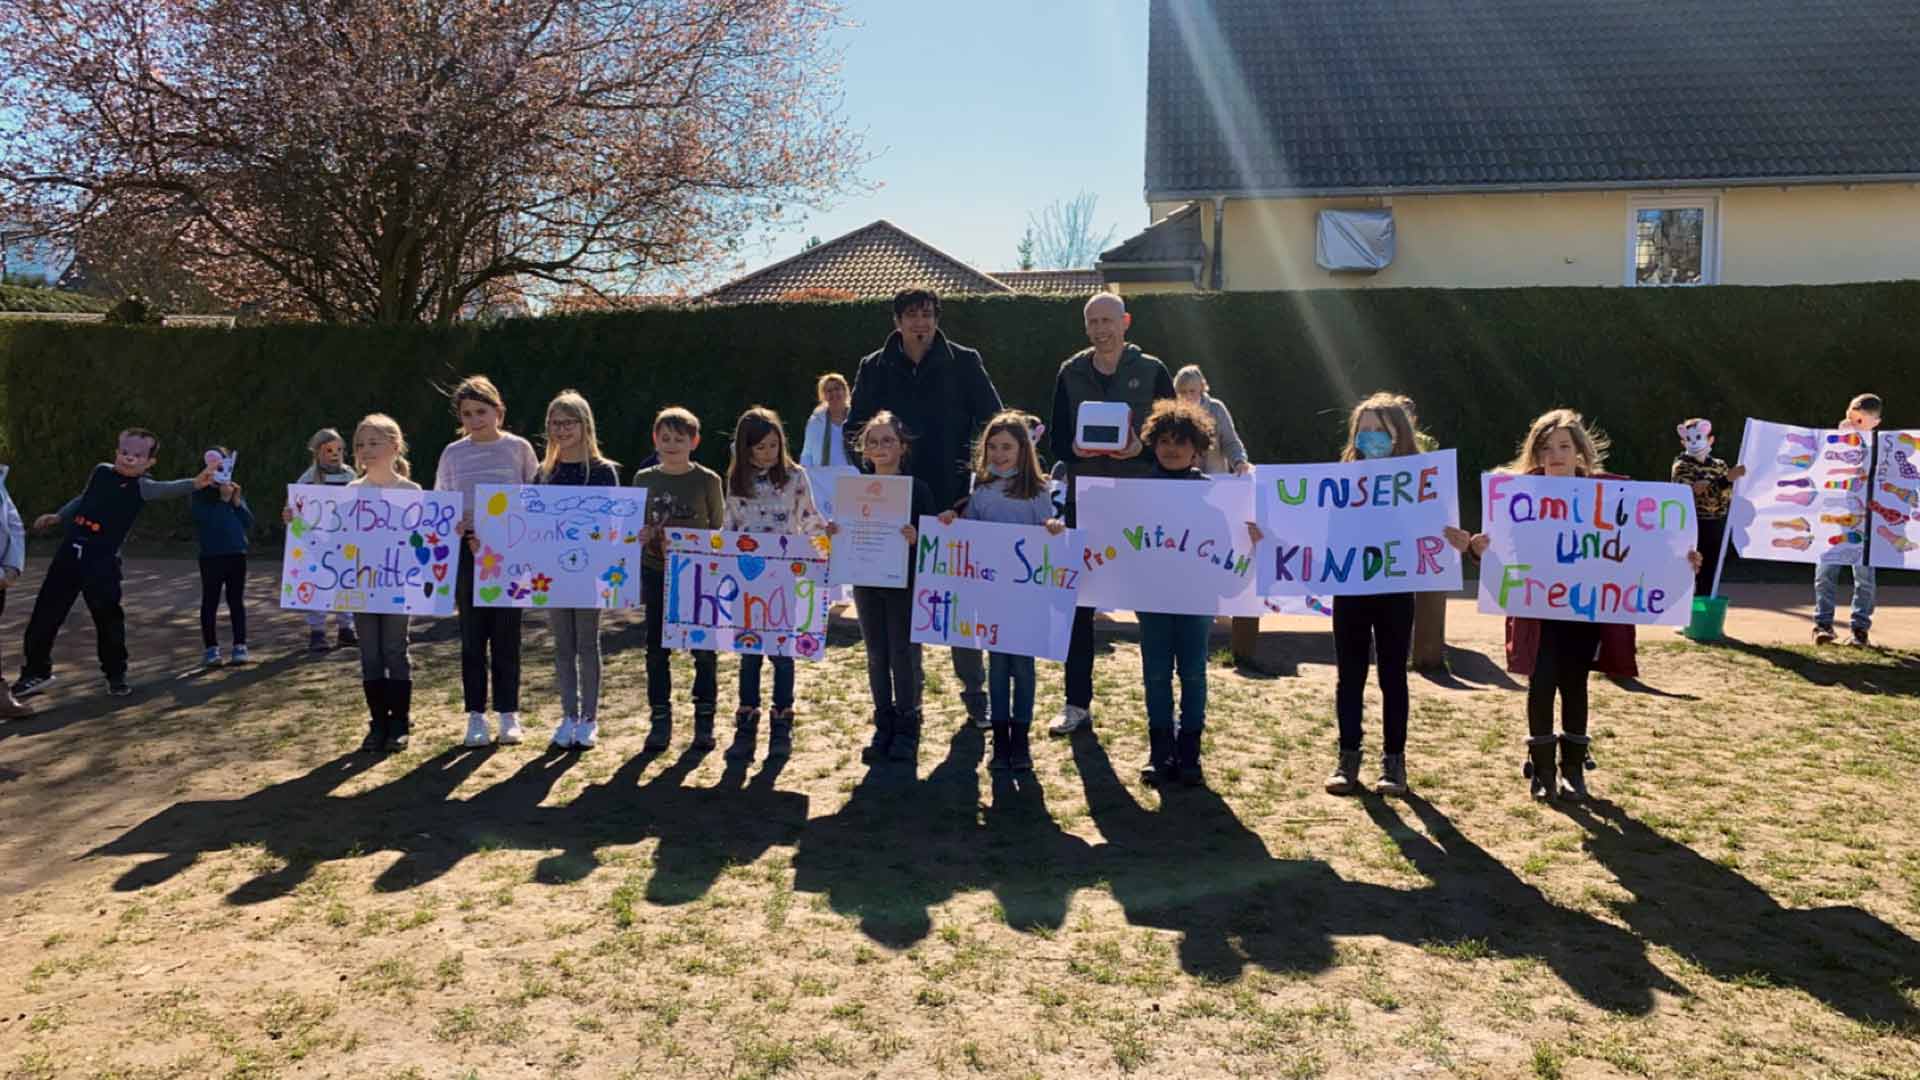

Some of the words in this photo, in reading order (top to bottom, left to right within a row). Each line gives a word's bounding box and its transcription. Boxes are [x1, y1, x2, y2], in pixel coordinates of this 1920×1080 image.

[1277, 466, 1438, 508] UNSERE
[308, 498, 456, 537] 23.152.028
[1122, 525, 1190, 551] Vital
[1556, 530, 1630, 563] und
[1275, 536, 1445, 583] KINDER
